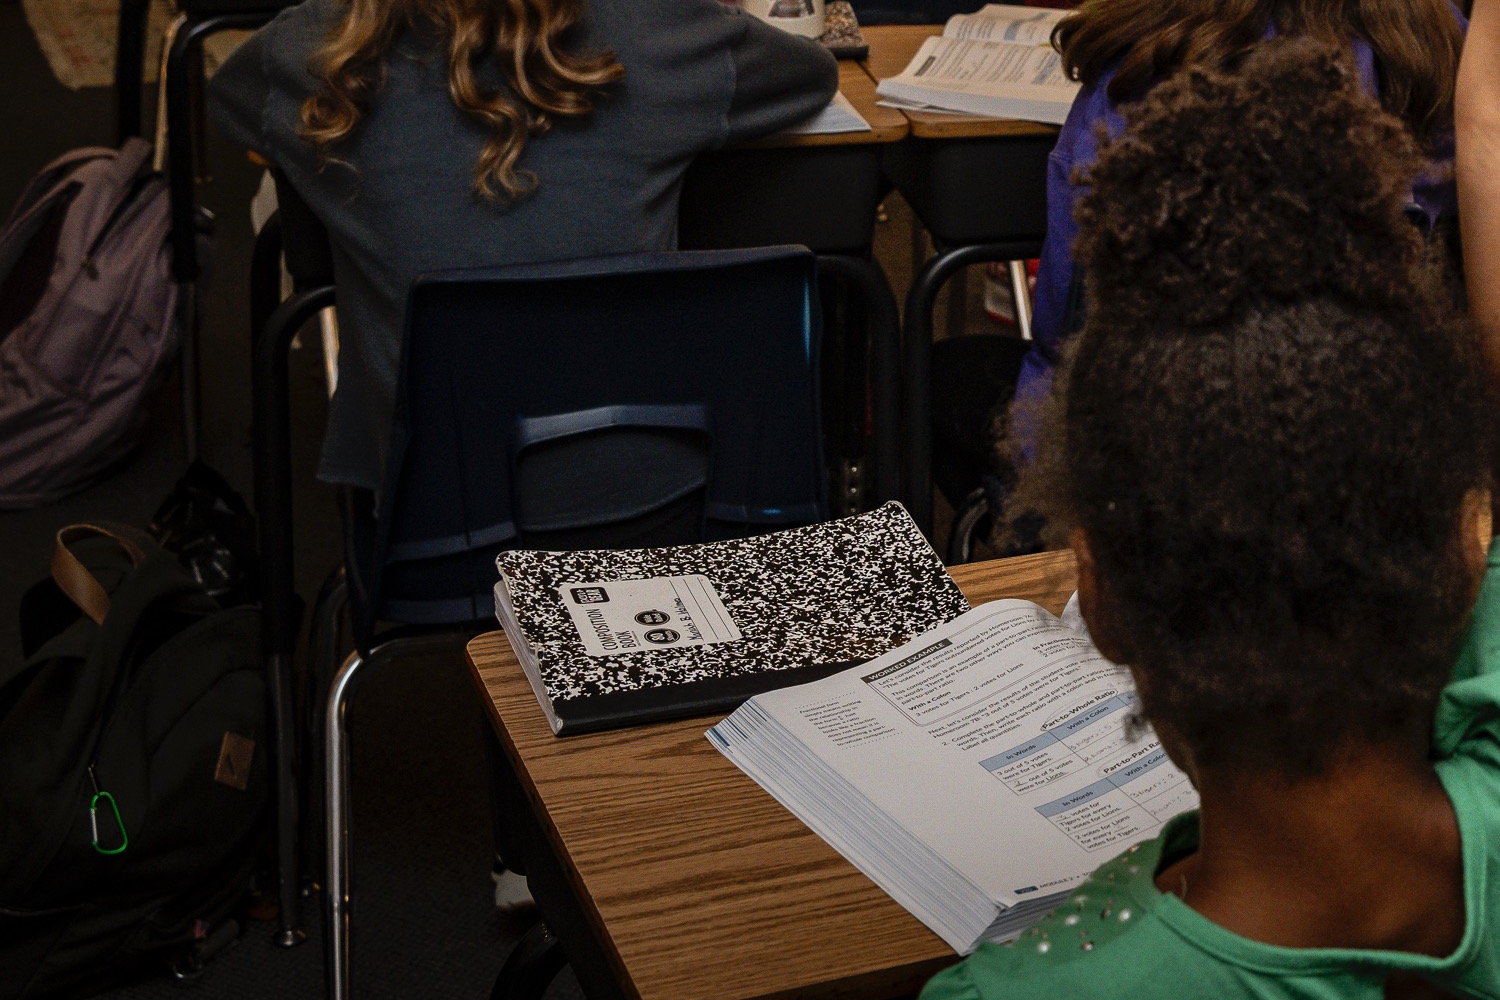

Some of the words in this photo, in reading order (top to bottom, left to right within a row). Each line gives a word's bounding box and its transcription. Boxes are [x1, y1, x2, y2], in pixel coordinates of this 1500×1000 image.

[585, 608, 619, 650] COMPOSITION
[614, 630, 637, 649] BOOK
[868, 660, 906, 680] WORKED
[908, 642, 944, 664] EXAMPLE
[894, 665, 919, 679] consider
[932, 649, 953, 660] results
[953, 634, 980, 650] reported
[906, 672, 941, 690] comparison
[957, 651, 982, 665] example
[995, 628, 1030, 646] part-to-part
[901, 686, 937, 704] part-to-part
[938, 679, 953, 688] ratio.
[908, 702, 926, 710] With
[931, 691, 951, 701] Colon
[921, 705, 939, 714] votes
[949, 691, 970, 701] Tigers
[979, 677, 996, 687] votes
[1006, 663, 1023, 673] Lions
[1042, 697, 1096, 730] Part-to-Whole
[1096, 690, 1116, 702] Ratio
[1067, 718, 1085, 730] With
[1089, 706, 1110, 718] Colon
[1013, 744, 1036, 757] Words
[1103, 746, 1147, 774] Part-to-Part
[1125, 764, 1142, 778] With
